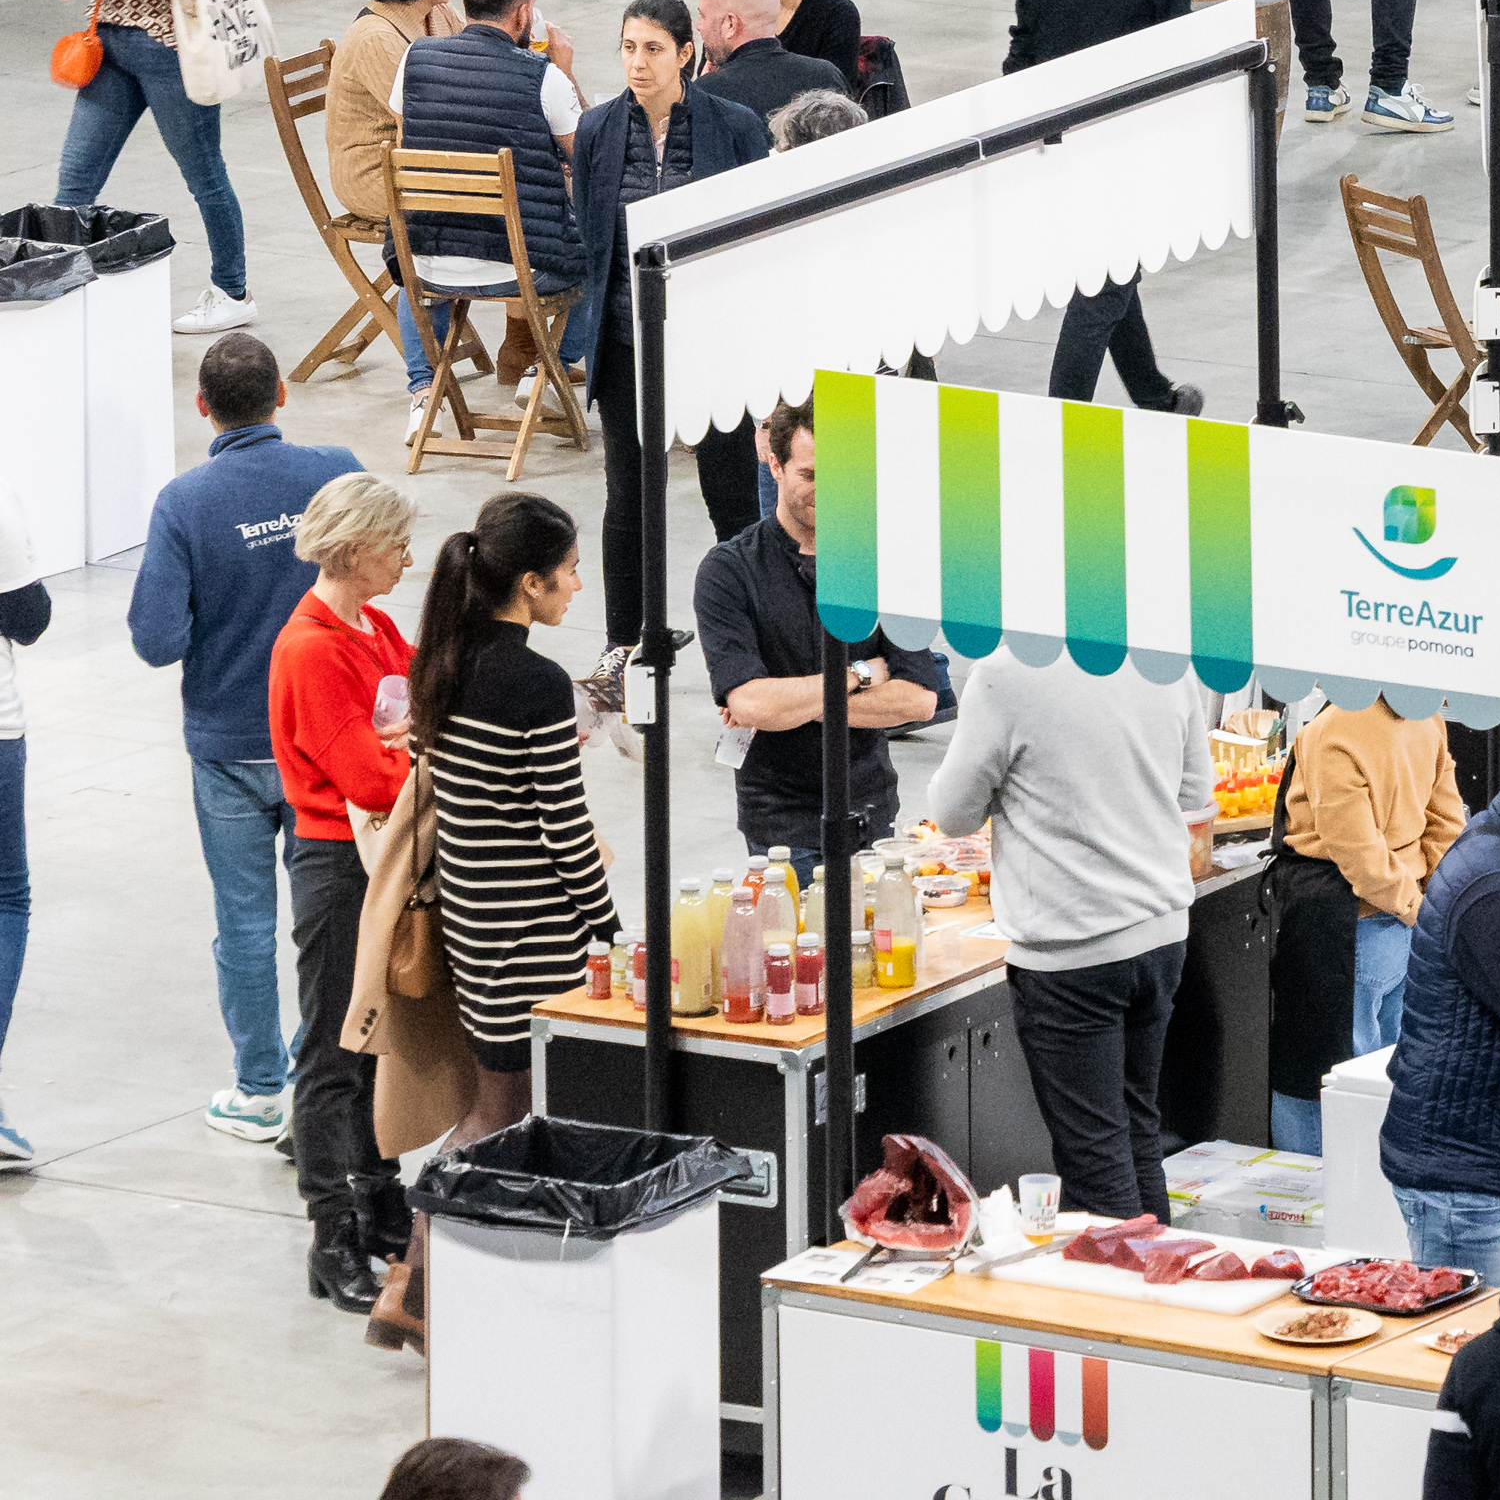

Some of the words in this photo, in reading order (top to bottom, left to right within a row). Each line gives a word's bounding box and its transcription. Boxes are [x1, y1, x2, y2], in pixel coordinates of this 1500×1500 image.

[235, 513, 302, 539] TerreAz
[1340, 589, 1484, 635] TerreAzur
[1350, 629, 1406, 649] groupe
[1407, 635, 1474, 658] pomona
[1003, 1446, 1073, 1500] La
